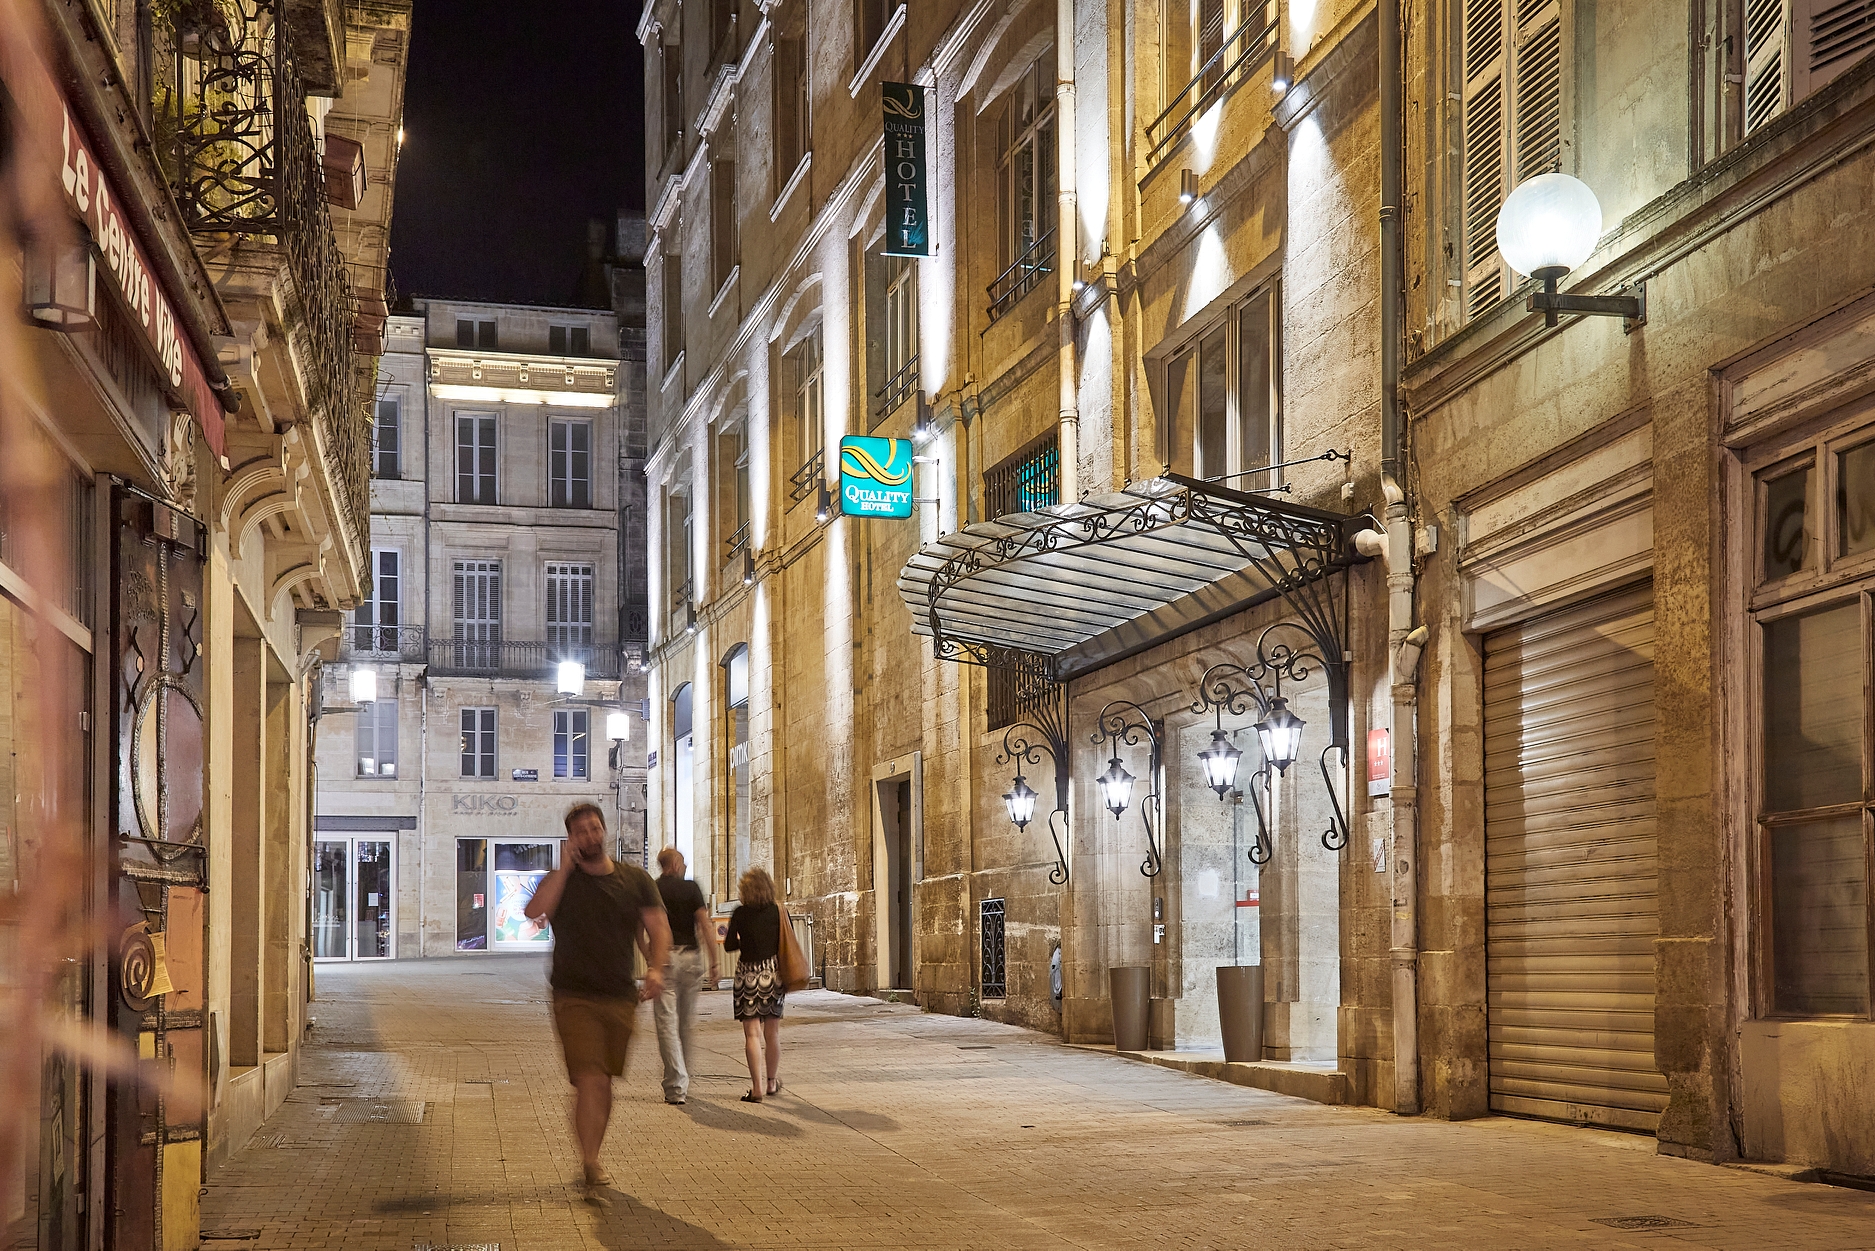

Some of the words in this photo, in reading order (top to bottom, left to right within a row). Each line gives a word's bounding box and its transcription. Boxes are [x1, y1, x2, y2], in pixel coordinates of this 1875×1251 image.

[885, 120, 925, 135] QUALITY
[896, 139, 917, 249] HOTEL
[62, 103, 90, 213] Le
[96, 169, 150, 328] Centre
[154, 283, 183, 388] Ville
[845, 484, 910, 504] QUALITY
[860, 501, 894, 513] HOTEL
[453, 794, 519, 811] KIKO
